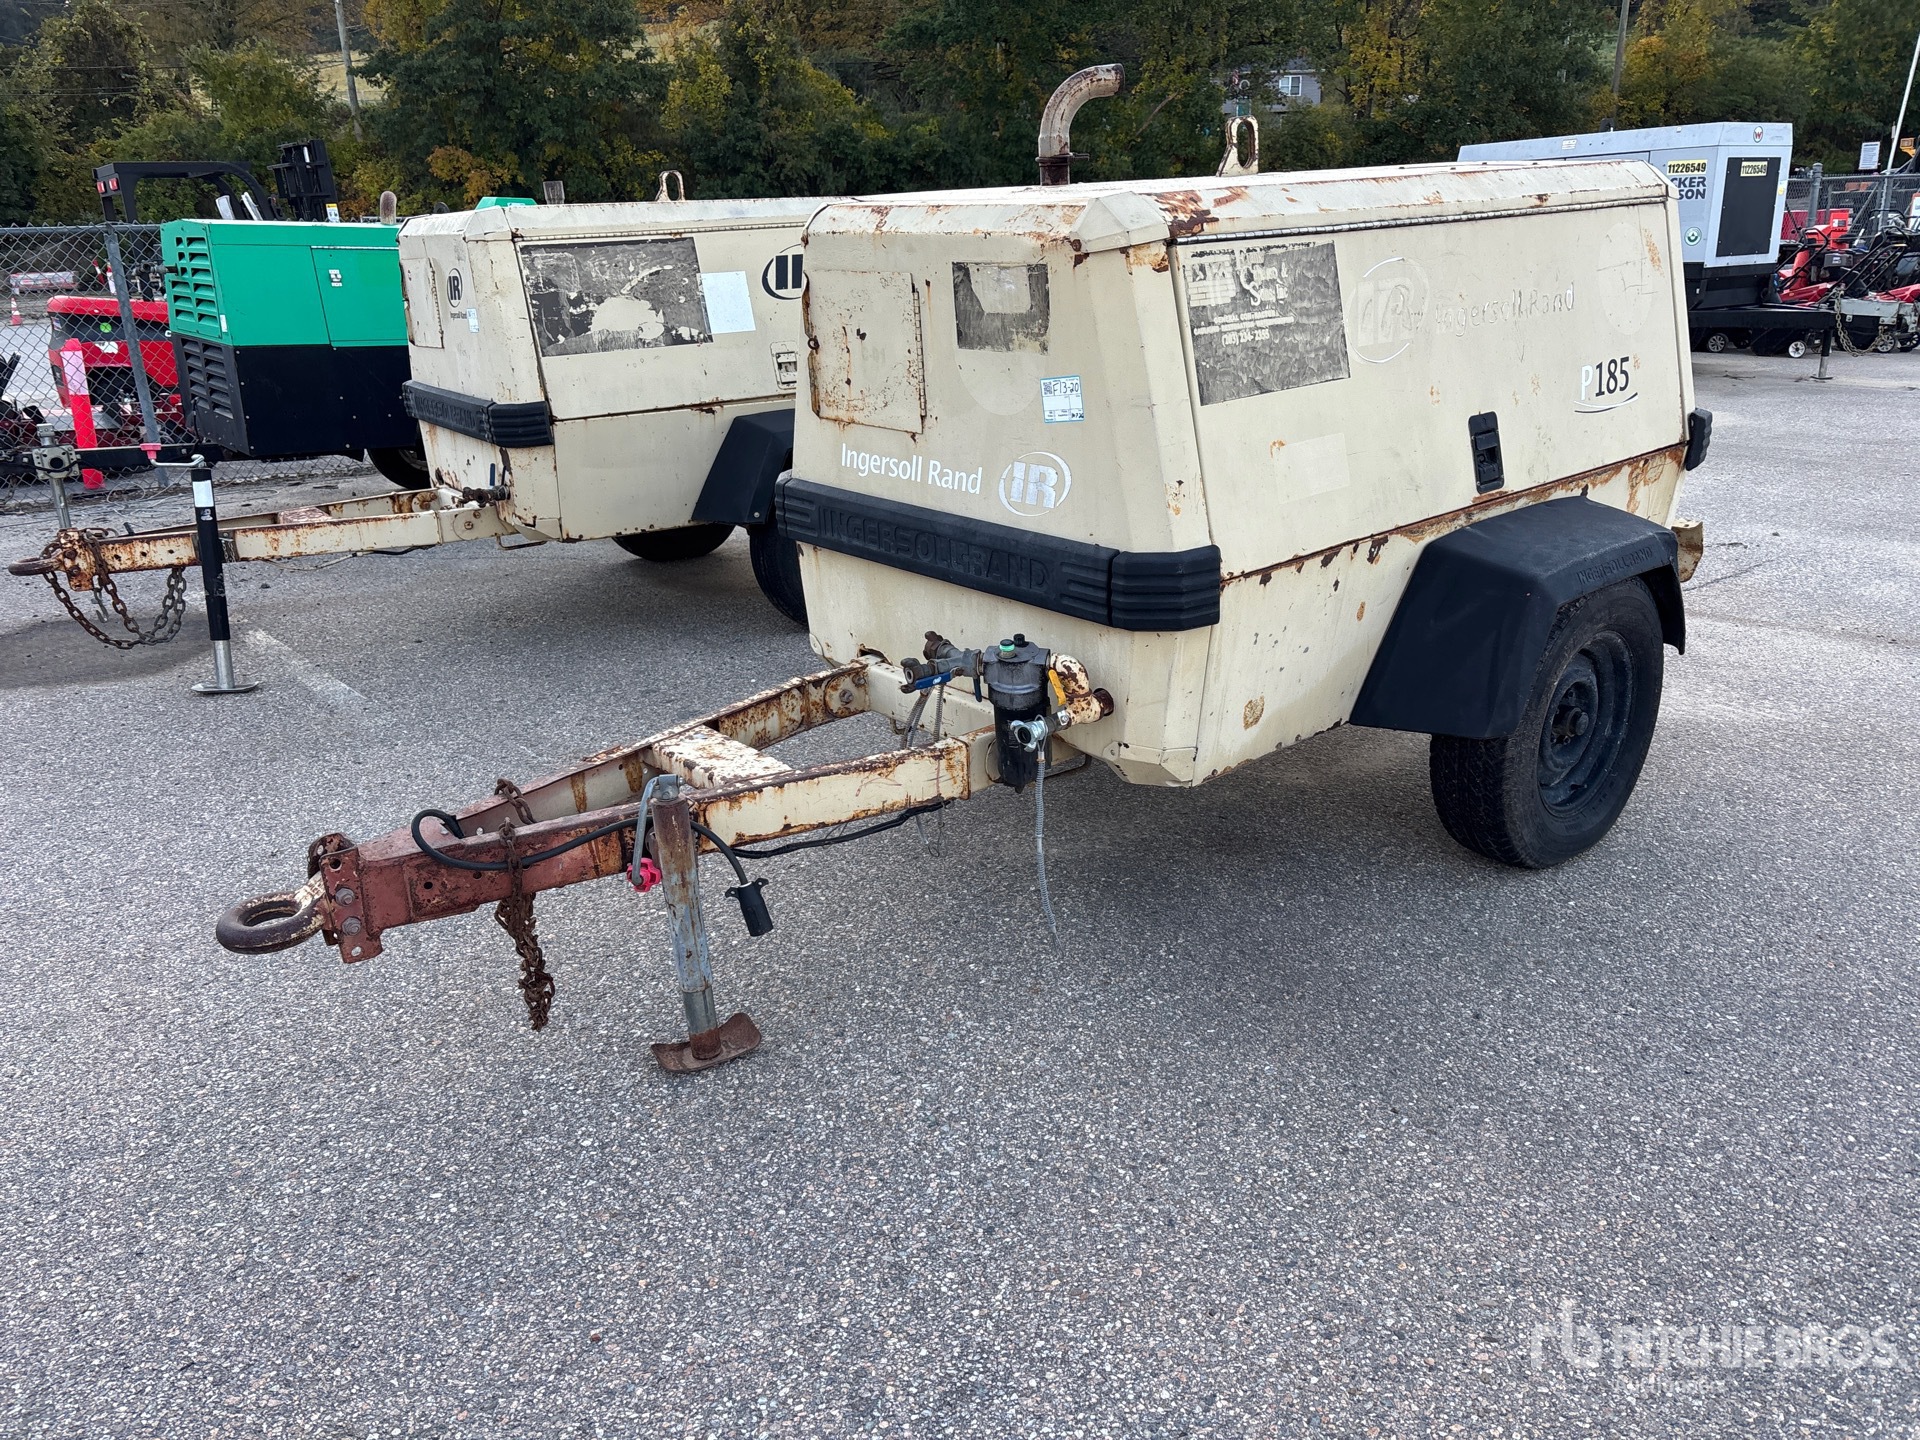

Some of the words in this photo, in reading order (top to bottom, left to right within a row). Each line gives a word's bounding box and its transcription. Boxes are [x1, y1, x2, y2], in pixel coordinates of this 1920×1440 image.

[1668, 162, 1707, 173] 11226549
[1741, 164, 1767, 175] 11226549
[1670, 176, 1707, 188] CKER
[1678, 188, 1706, 200] SON
[448, 275, 461, 301] IR
[1581, 356, 1629, 400] P185
[841, 443, 923, 483] Ingersoll
[927, 459, 983, 495] Rand
[1009, 461, 1059, 509] IR
